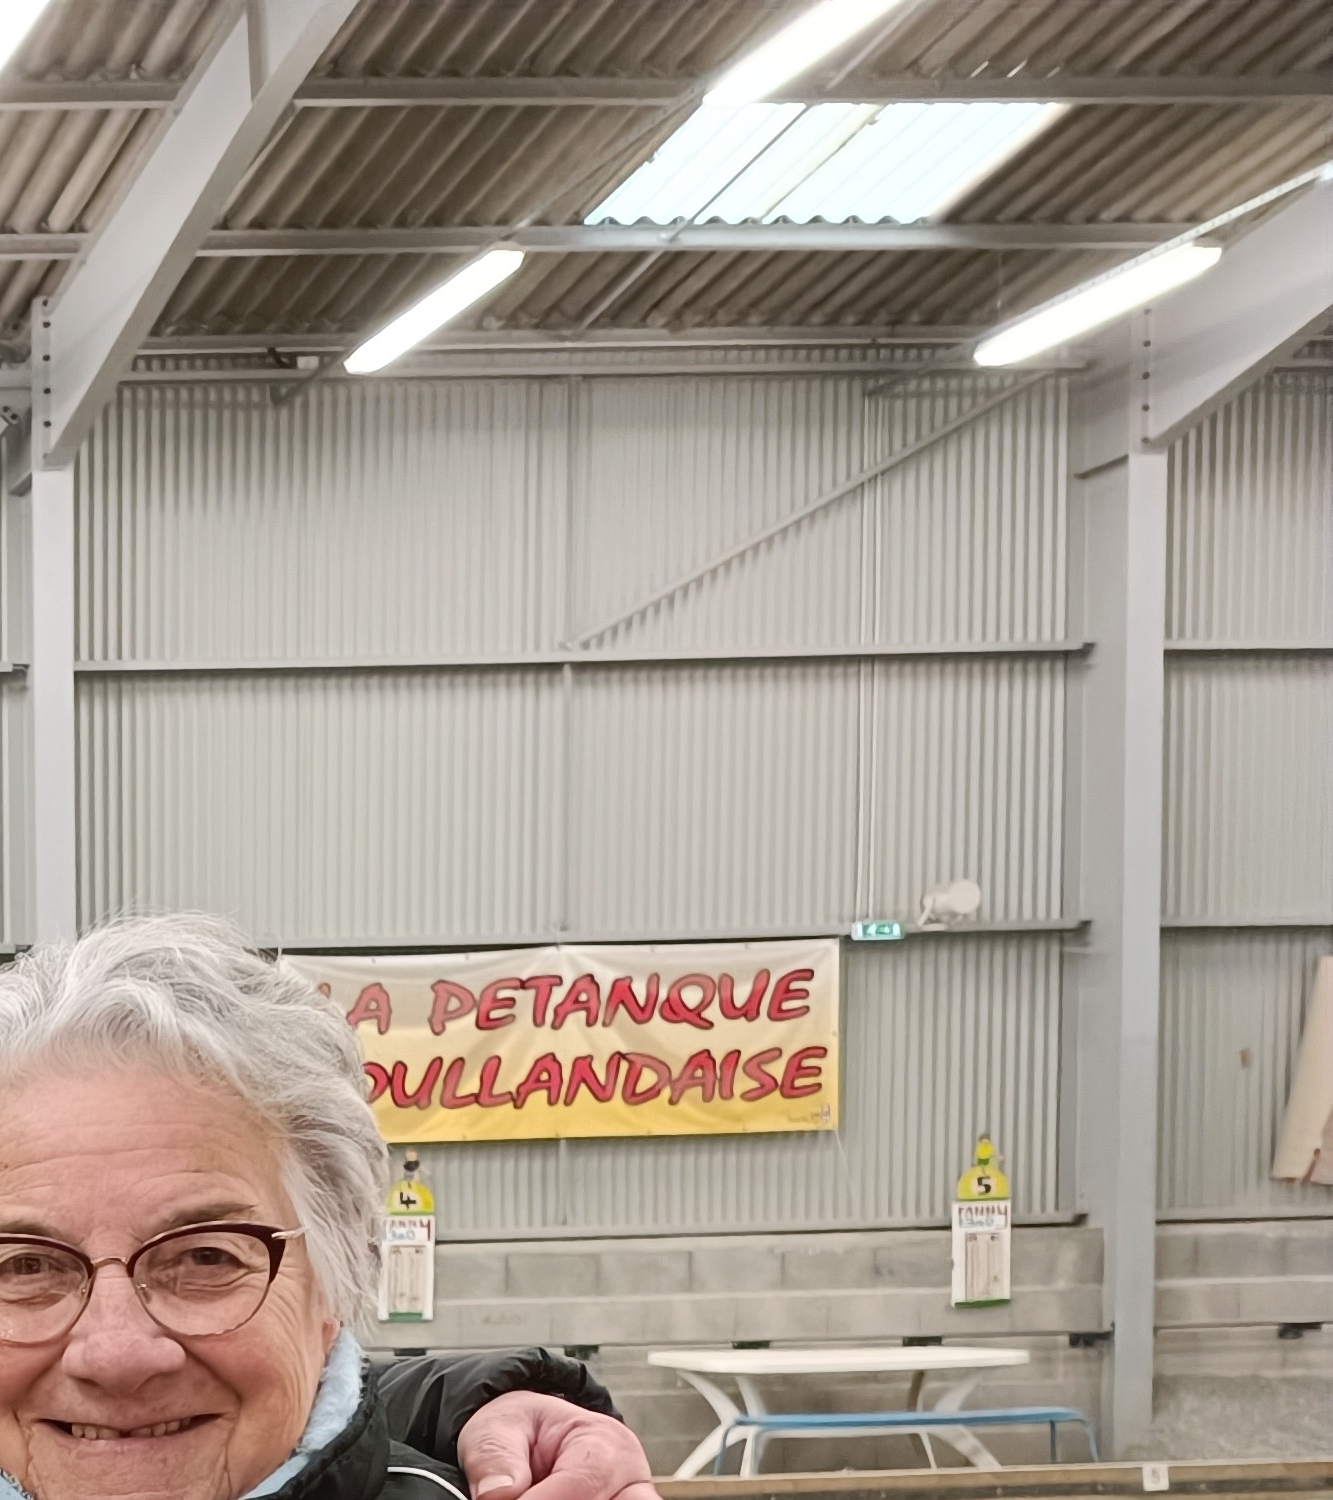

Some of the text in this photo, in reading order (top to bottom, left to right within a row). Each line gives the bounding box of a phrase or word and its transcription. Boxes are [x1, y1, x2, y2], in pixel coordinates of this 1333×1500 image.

[428, 967, 815, 1036] PETANQUE
[975, 1175, 993, 1196] 5
[399, 1191, 417, 1210] 4
